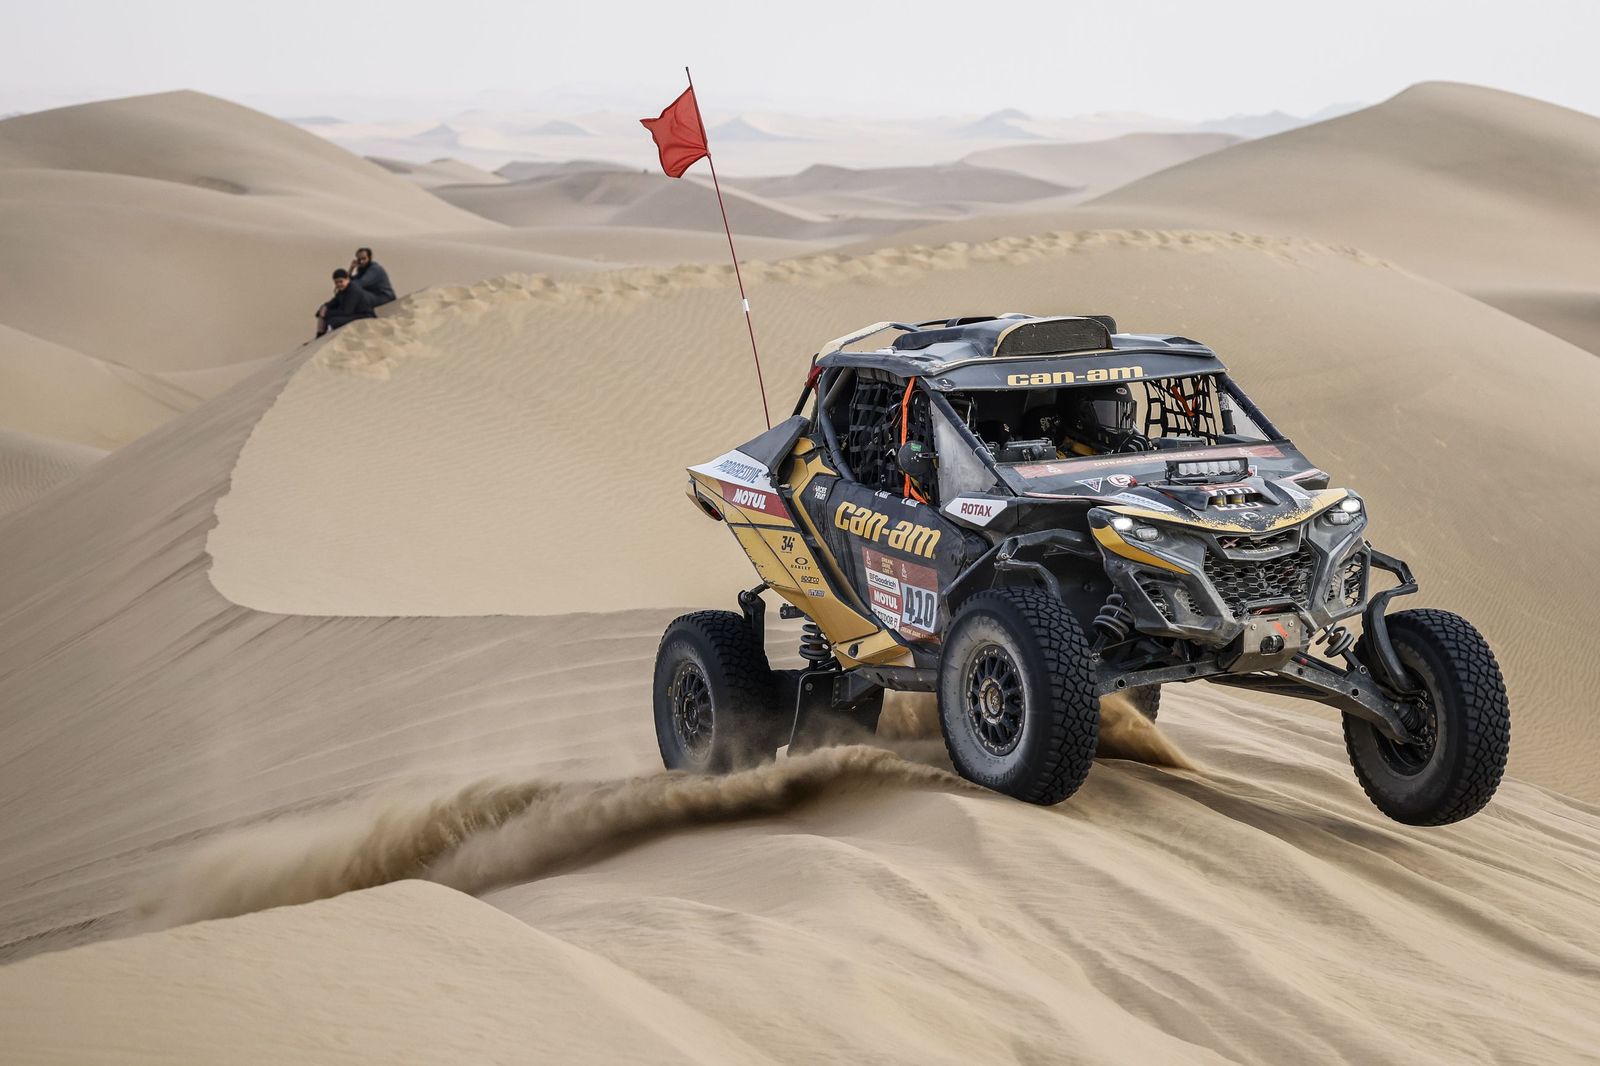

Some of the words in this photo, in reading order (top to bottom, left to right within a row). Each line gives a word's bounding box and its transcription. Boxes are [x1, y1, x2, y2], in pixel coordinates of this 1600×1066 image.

[1007, 366, 1144, 386] can-am
[732, 488, 767, 510] MOTUL
[960, 503, 993, 517] ROTAX
[834, 501, 941, 559] can-am
[873, 590, 898, 609] MOTUL
[904, 587, 935, 628] 410
[877, 611, 894, 626] TUDOR
